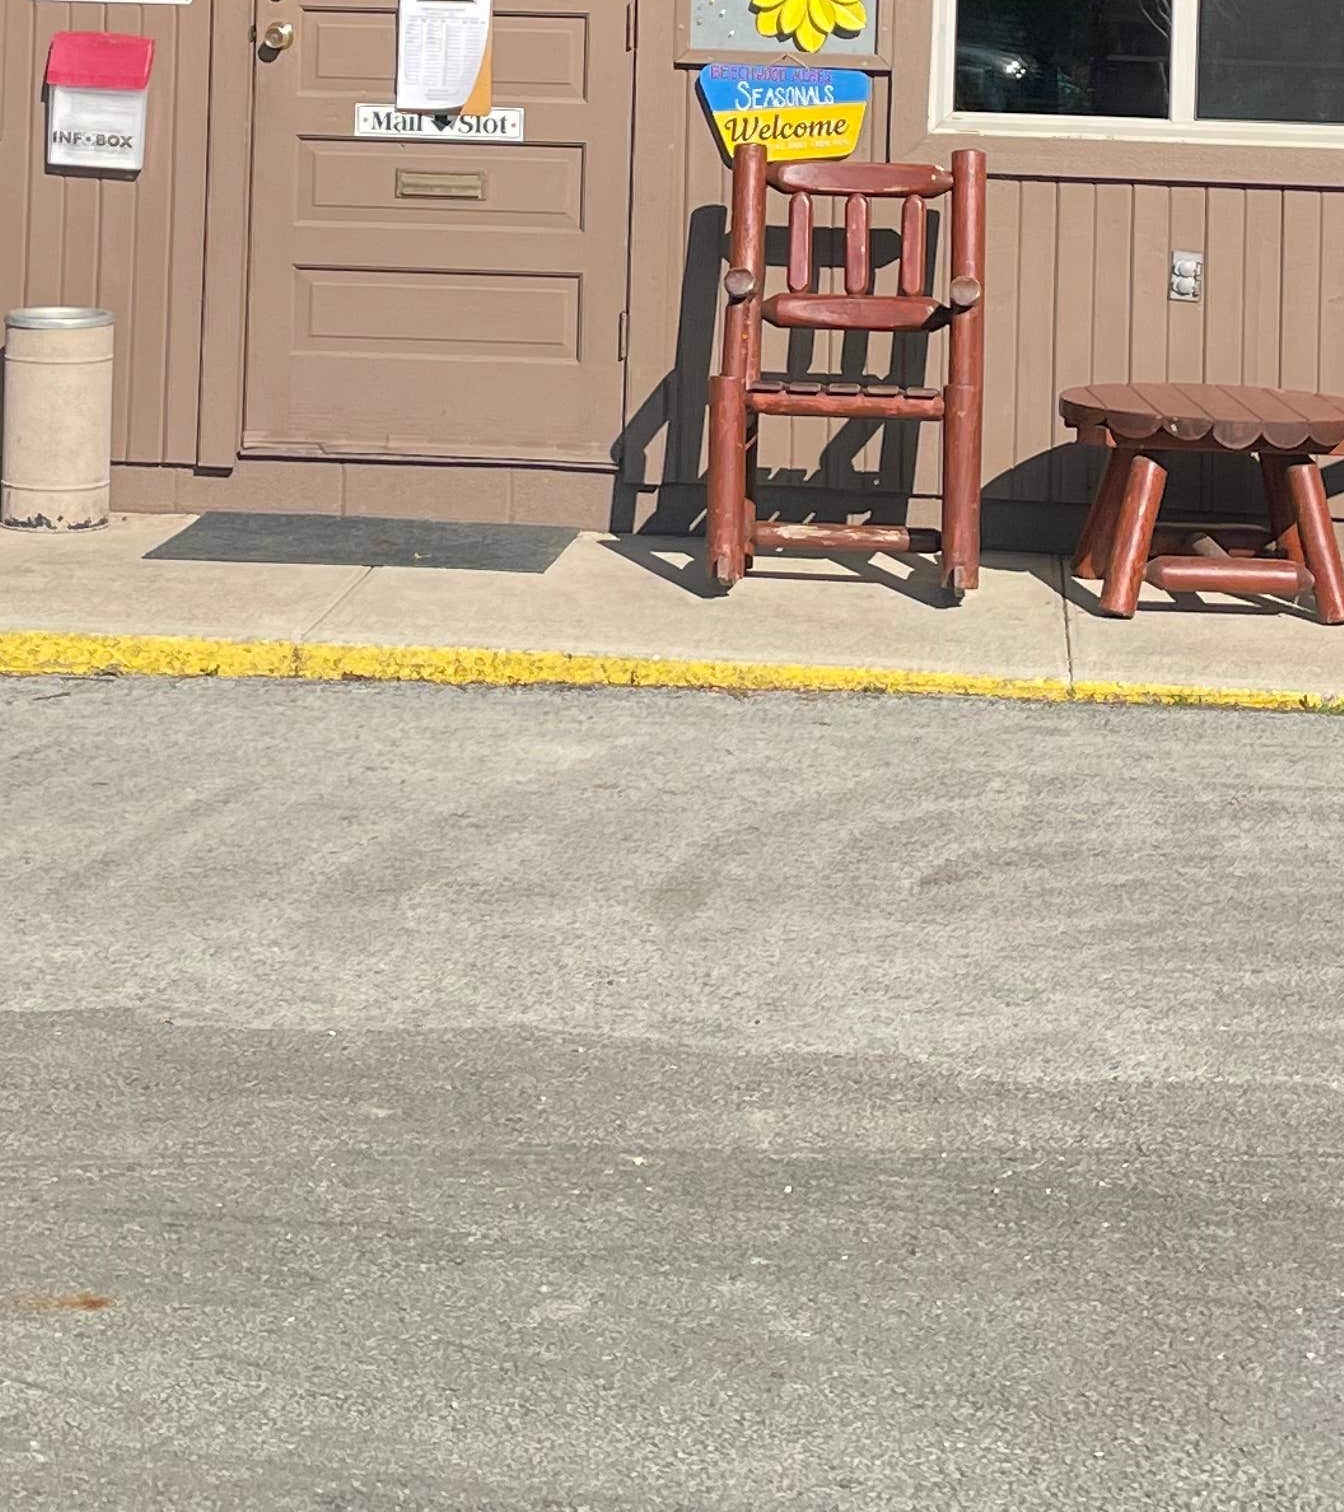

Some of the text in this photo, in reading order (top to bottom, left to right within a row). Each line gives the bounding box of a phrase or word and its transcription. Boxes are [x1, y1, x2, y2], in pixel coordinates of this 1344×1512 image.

[370, 110, 509, 135] Mail Slot
[723, 114, 848, 143] Welcome
